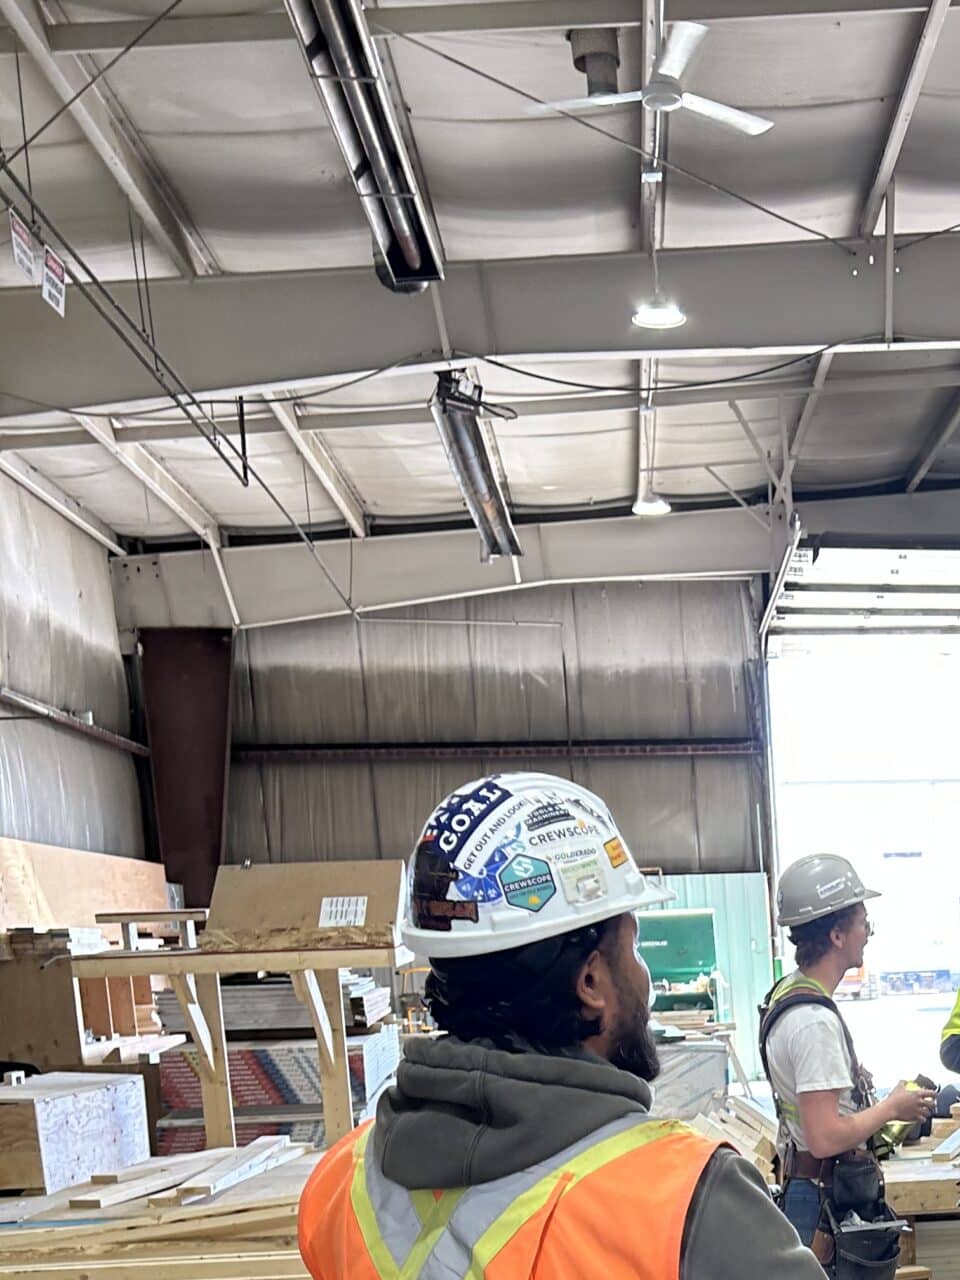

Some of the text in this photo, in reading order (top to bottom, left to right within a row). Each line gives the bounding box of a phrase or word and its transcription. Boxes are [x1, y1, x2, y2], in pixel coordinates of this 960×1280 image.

[463, 851, 477, 870] GET
[475, 833, 491, 852] OUT
[488, 818, 506, 835] AND
[529, 824, 600, 846] CREWSCOPE
[504, 873, 552, 892] CREWSCOPE
